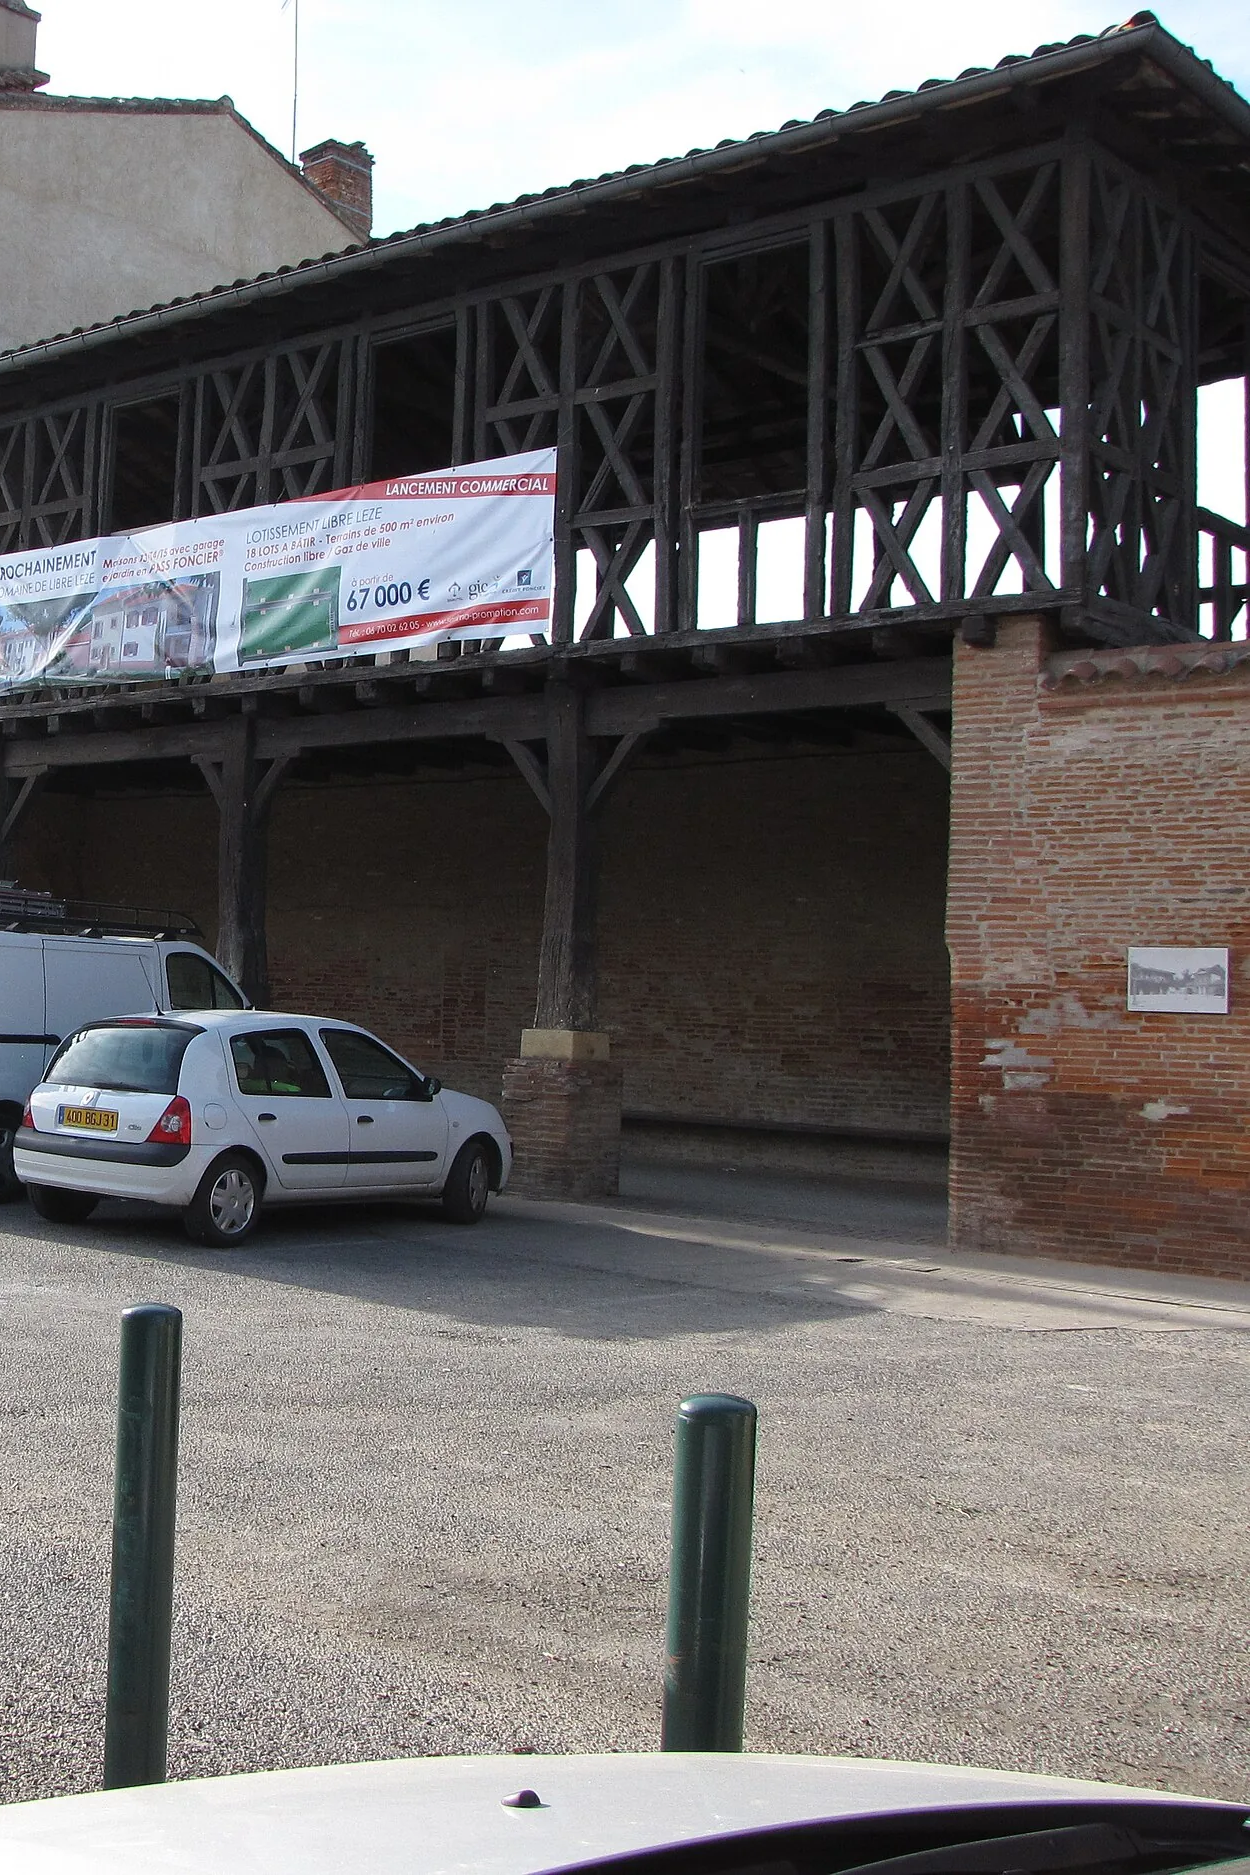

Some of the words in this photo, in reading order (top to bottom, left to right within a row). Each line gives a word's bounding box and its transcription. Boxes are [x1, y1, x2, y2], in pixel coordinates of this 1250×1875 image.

[386, 481, 457, 496] LANCEMENT
[460, 477, 549, 494] COMMERCIAL
[246, 519, 320, 544] LOTISSEMENT
[322, 512, 353, 530] LIBRE
[356, 507, 382, 523] LEZE
[246, 548, 256, 558] 18
[258, 544, 279, 556] LOTS
[326, 530, 361, 544] Terrains
[364, 526, 376, 537] de
[379, 522, 398, 534] 500
[400, 518, 415, 530] m²
[416, 512, 455, 527] environ
[169, 544, 190, 556] avec
[192, 538, 225, 554] garage
[244, 554, 301, 572] Construction
[304, 550, 326, 562] libre
[334, 545, 353, 556] Gaz
[356, 541, 369, 552] de
[371, 537, 391, 549] ville
[136, 568, 147, 577] en
[149, 560, 171, 574] PASS
[34, 580, 47, 593] DE
[49, 576, 72, 591] LIBRE
[75, 572, 95, 587] LEZE
[359, 574, 381, 588] partir
[382, 573, 394, 583] de
[468, 580, 488, 600] gic
[347, 588, 370, 611] 67
[375, 582, 412, 608] 000
[417, 579, 431, 601] €
[377, 625, 386, 633] 70
[387, 623, 397, 632] 02
[398, 621, 408, 631] 62
[409, 620, 419, 630] 05
[67, 1110, 82, 1124] 400
[85, 1112, 102, 1125] BGJ
[103, 1113, 115, 1127] 31
